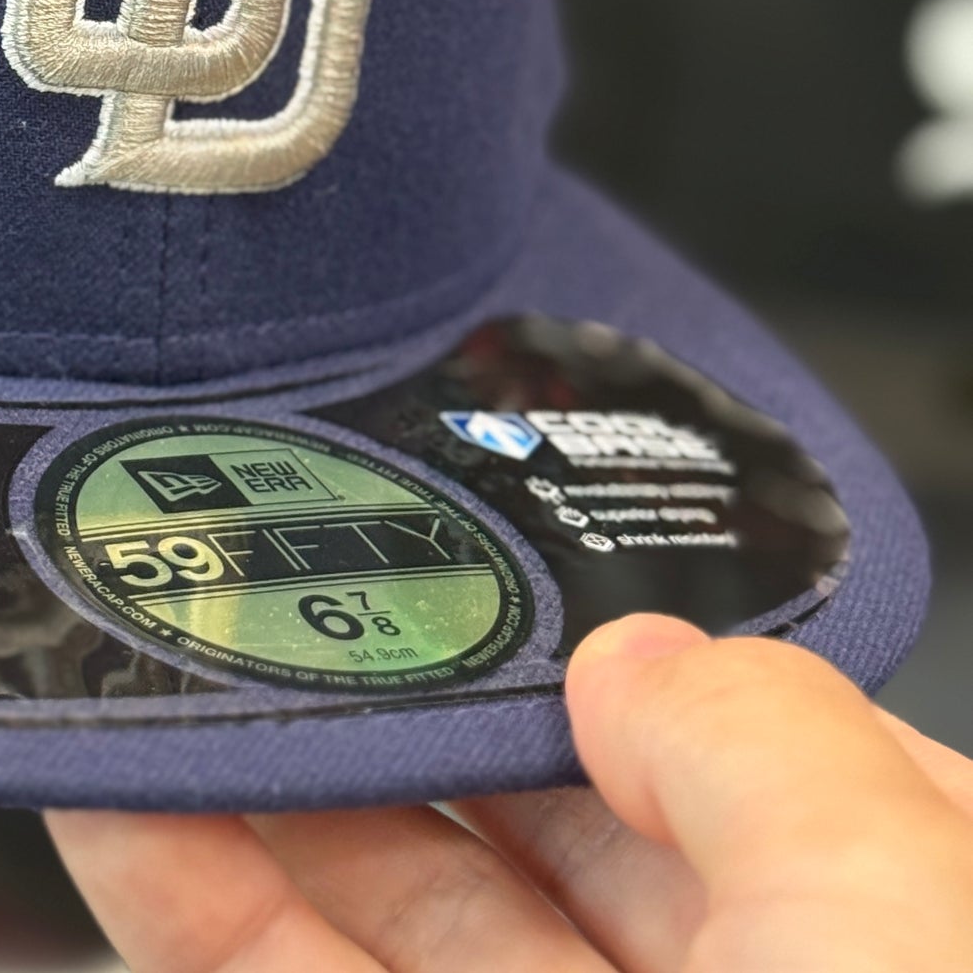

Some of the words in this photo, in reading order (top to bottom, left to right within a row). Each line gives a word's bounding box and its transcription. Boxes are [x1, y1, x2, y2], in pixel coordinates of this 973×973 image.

[92, 425, 174, 457] ORIGINATORS
[81, 453, 98, 467] OF
[230, 460, 298, 478] NEW
[65, 464, 88, 481] THE
[245, 476, 313, 493] ERA
[55, 502, 71, 536] FITTED
[64, 545, 158, 629] NEWERACAP.COM
[177, 635, 292, 678] ORIGINATORS
[295, 670, 324, 682] OF
[326, 674, 359, 686] THE
[361, 675, 404, 686] TRUE
[406, 666, 455, 684] FITTED
[348, 647, 418, 663] 54.9cm
